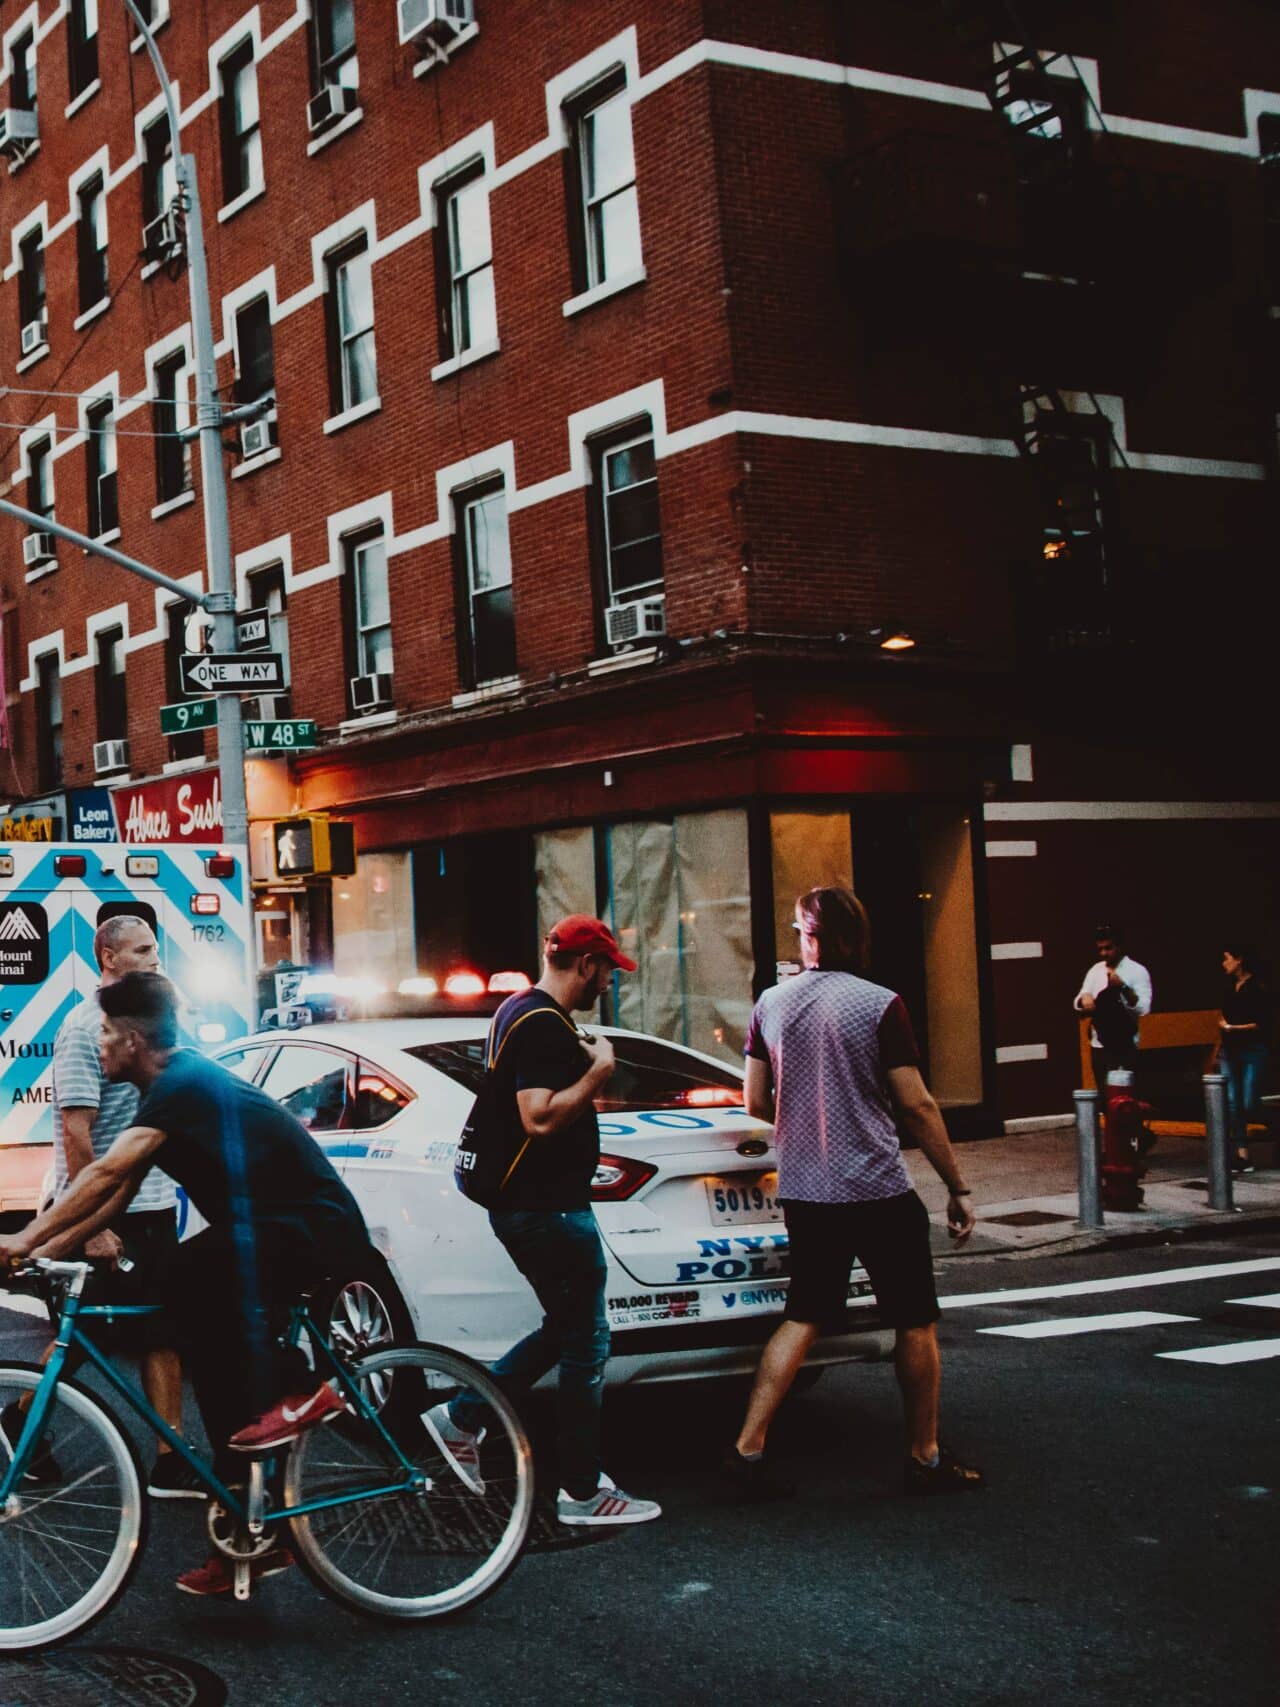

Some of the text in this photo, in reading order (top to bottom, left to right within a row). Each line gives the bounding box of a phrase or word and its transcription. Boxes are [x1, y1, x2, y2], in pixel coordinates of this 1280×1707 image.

[240, 623, 260, 639] WAY
[198, 665, 271, 681] ONE WAY
[177, 704, 205, 728] 9 AV
[250, 723, 310, 747] W 48 ST
[79, 806, 109, 822] Leon
[177, 776, 223, 836] Sush
[3, 816, 52, 842] Bakery
[74, 823, 117, 841] Bakery
[191, 924, 225, 942] 1762
[714, 1186, 764, 1213] 5019
[696, 1233, 791, 1258] NYP
[608, 1294, 652, 1311] $10,000
